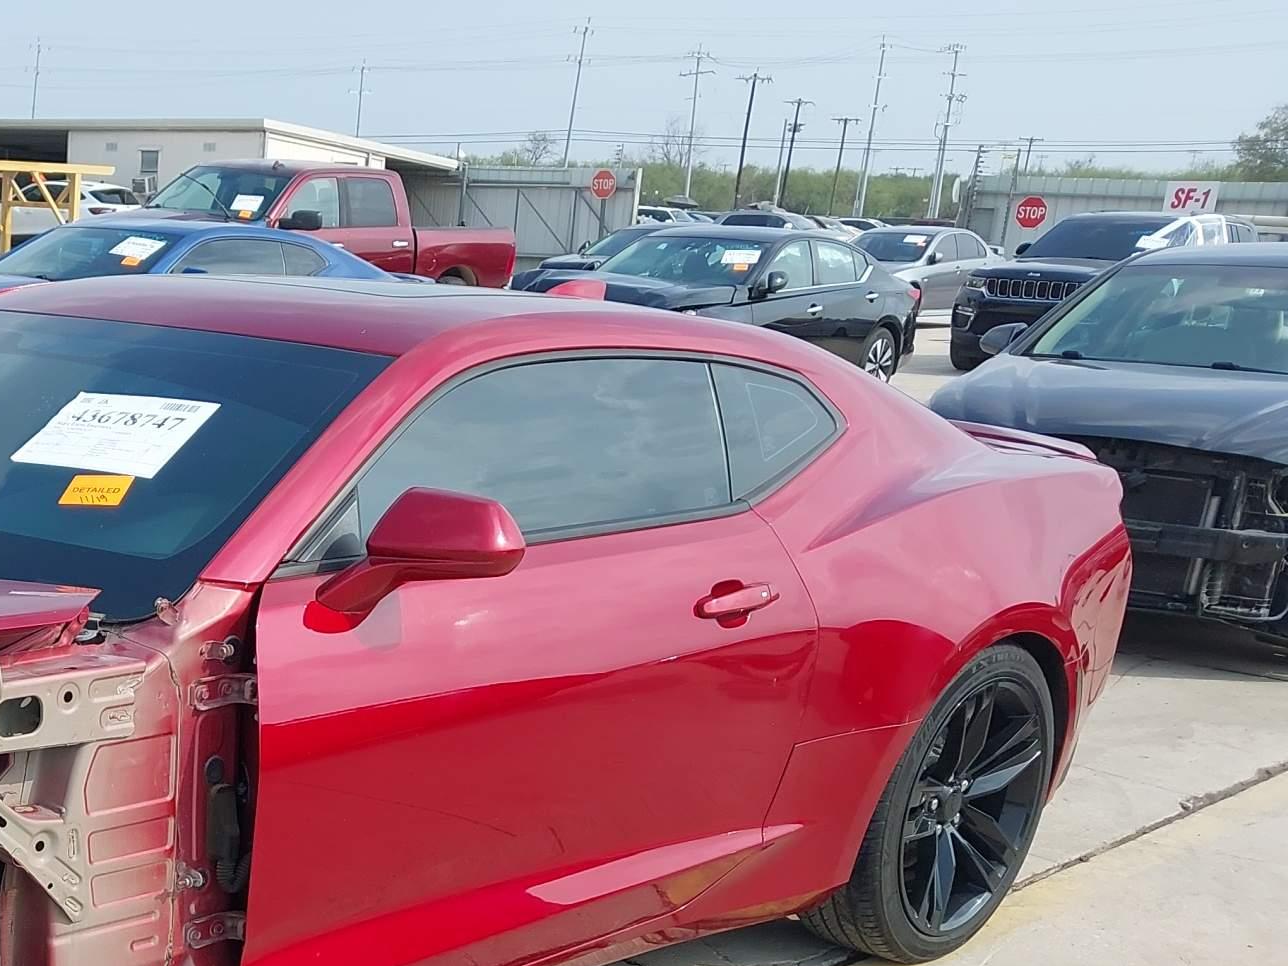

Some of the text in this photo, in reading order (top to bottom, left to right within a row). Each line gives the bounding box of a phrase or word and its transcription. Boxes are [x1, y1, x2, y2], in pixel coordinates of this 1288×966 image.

[593, 179, 614, 190] STOP
[1171, 188, 1211, 209] SF-1
[1018, 206, 1045, 219] STOP
[72, 408, 187, 430] 43678747
